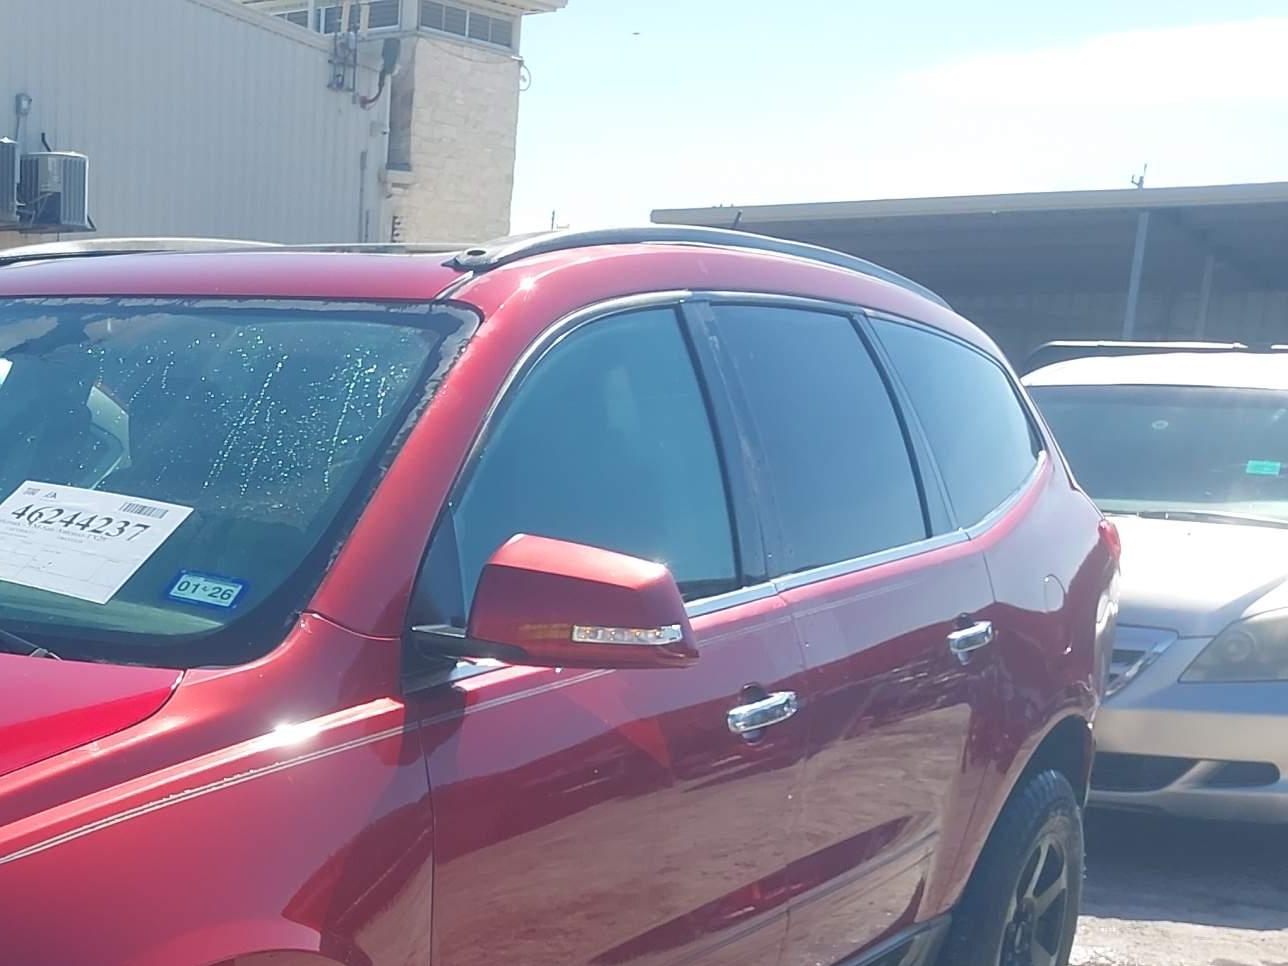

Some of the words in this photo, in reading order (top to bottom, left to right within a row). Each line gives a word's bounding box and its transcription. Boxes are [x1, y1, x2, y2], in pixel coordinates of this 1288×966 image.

[12, 503, 151, 541] 46244237
[177, 580, 201, 594] 01
[208, 586, 234, 600] 26
